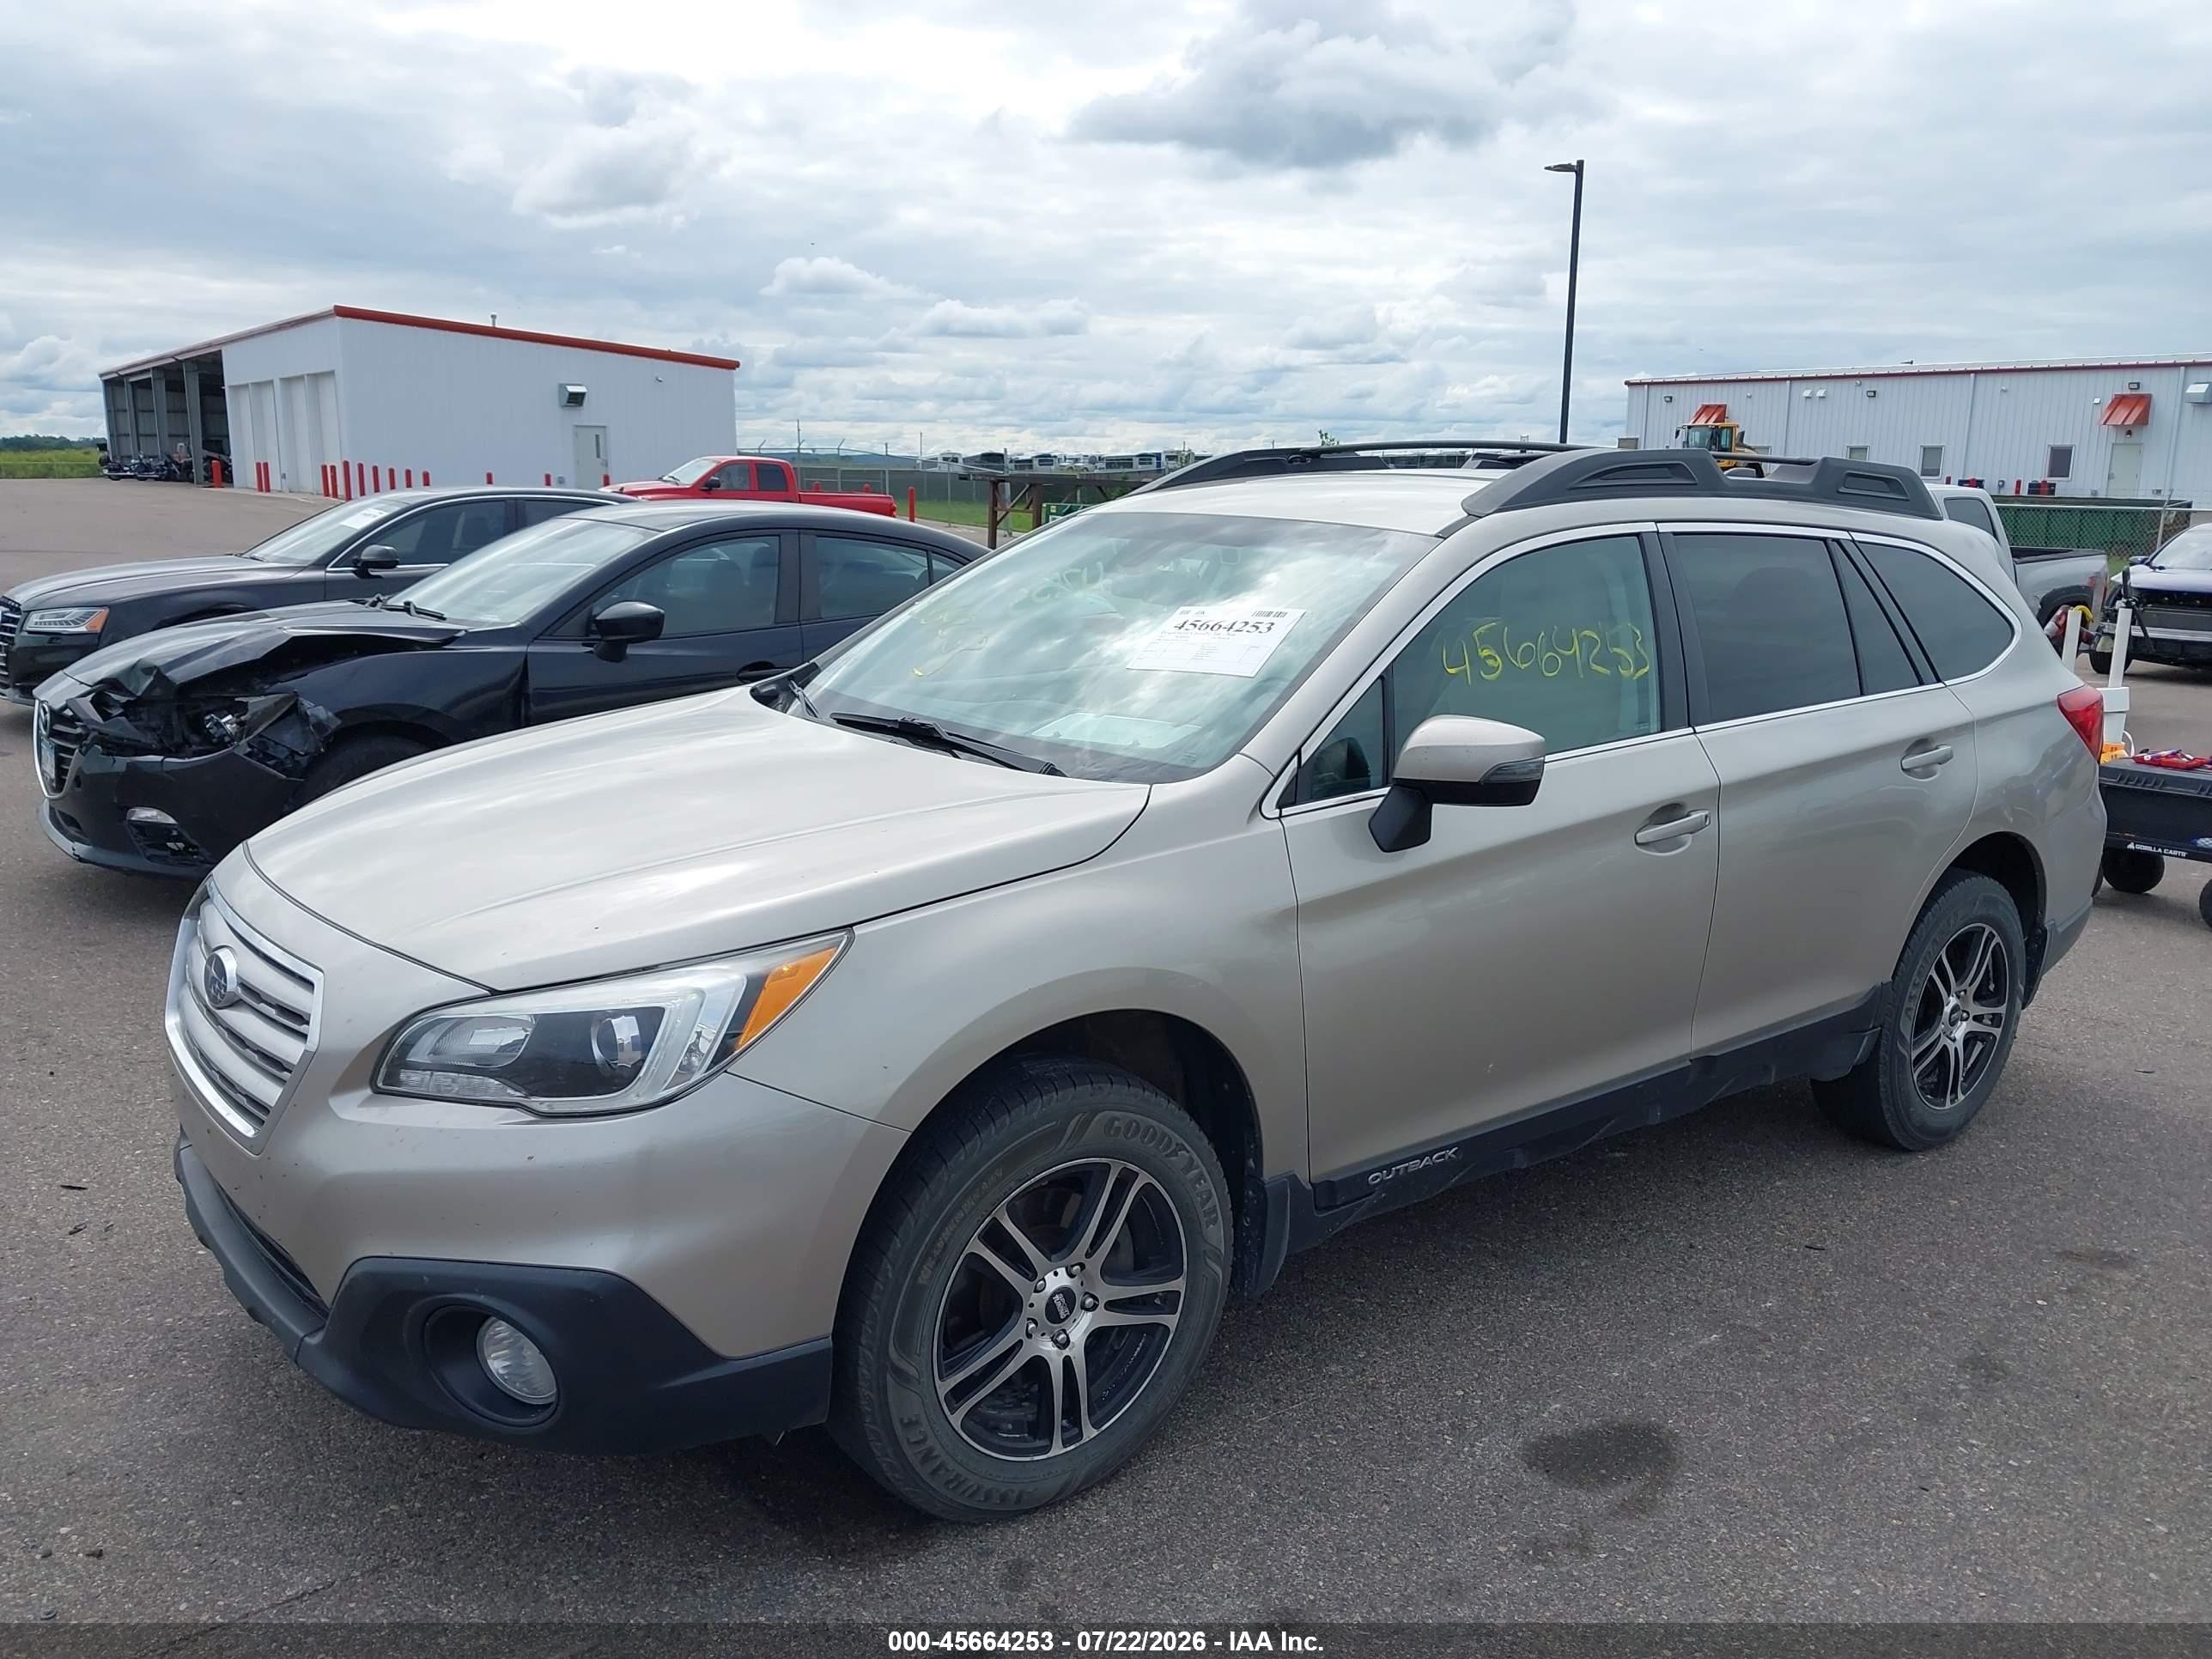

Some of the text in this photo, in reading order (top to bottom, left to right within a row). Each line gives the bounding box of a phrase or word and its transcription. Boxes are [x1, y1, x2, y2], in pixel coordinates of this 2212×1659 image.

[1173, 619, 1276, 634] 45664253
[1442, 622, 1650, 685] 45664253
[2135, 843, 2162, 854] GORILLA
[1103, 1116, 1219, 1230] GOODYEAR
[1367, 1146, 1458, 1185] OUTBACK
